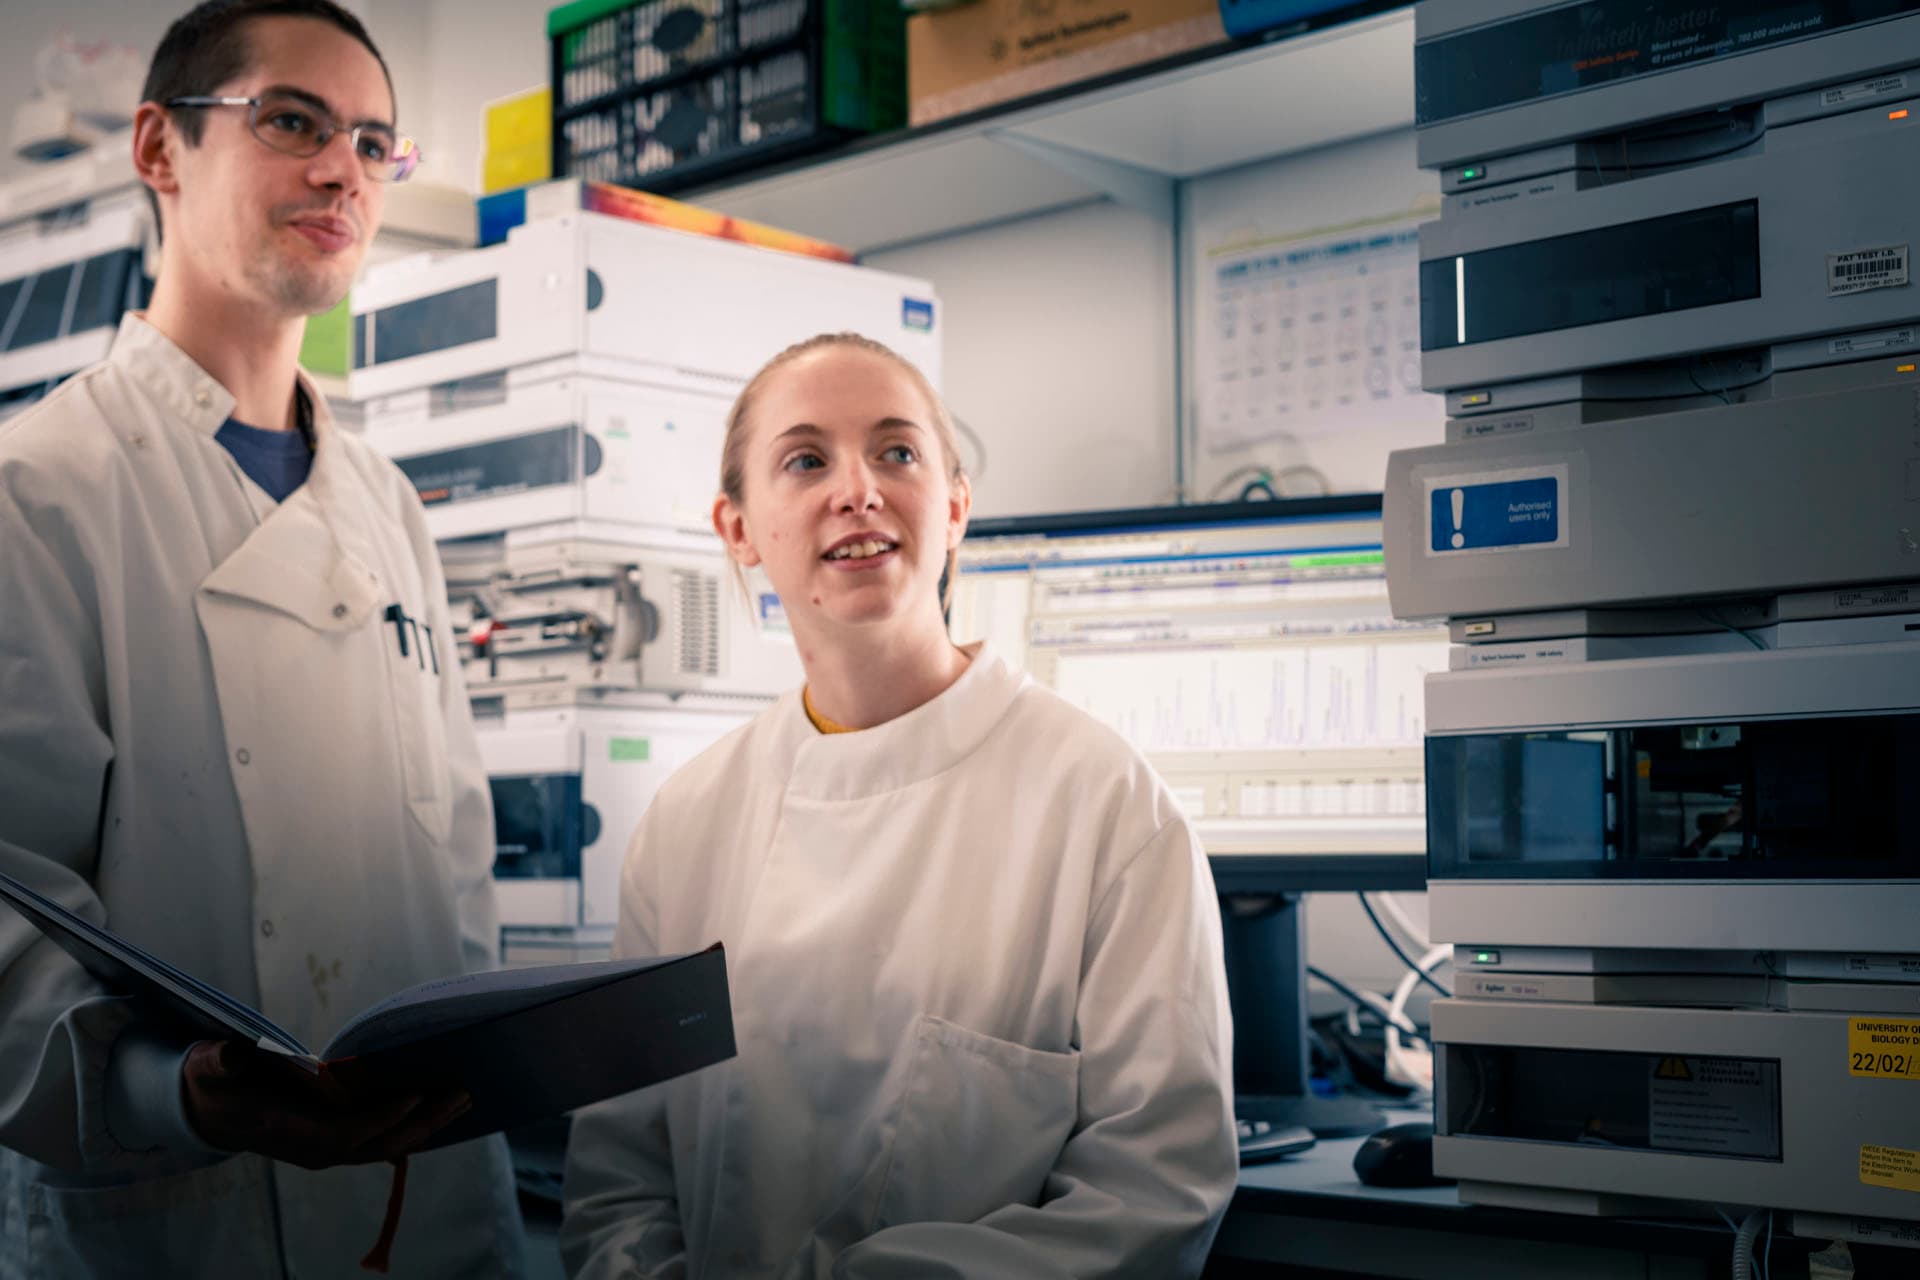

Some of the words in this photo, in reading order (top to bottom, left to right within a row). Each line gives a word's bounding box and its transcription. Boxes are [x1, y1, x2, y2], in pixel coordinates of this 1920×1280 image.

[1662, 51, 1683, 64] years
[1837, 254, 1854, 263] PAT
[1856, 249, 1880, 261] TEST
[1508, 499, 1552, 513] Authorised
[1509, 512, 1532, 523] users
[1533, 510, 1551, 523] only
[1856, 1022, 1909, 1033] UNIVERSITY
[1871, 1034, 1910, 1045] BIOLOGY
